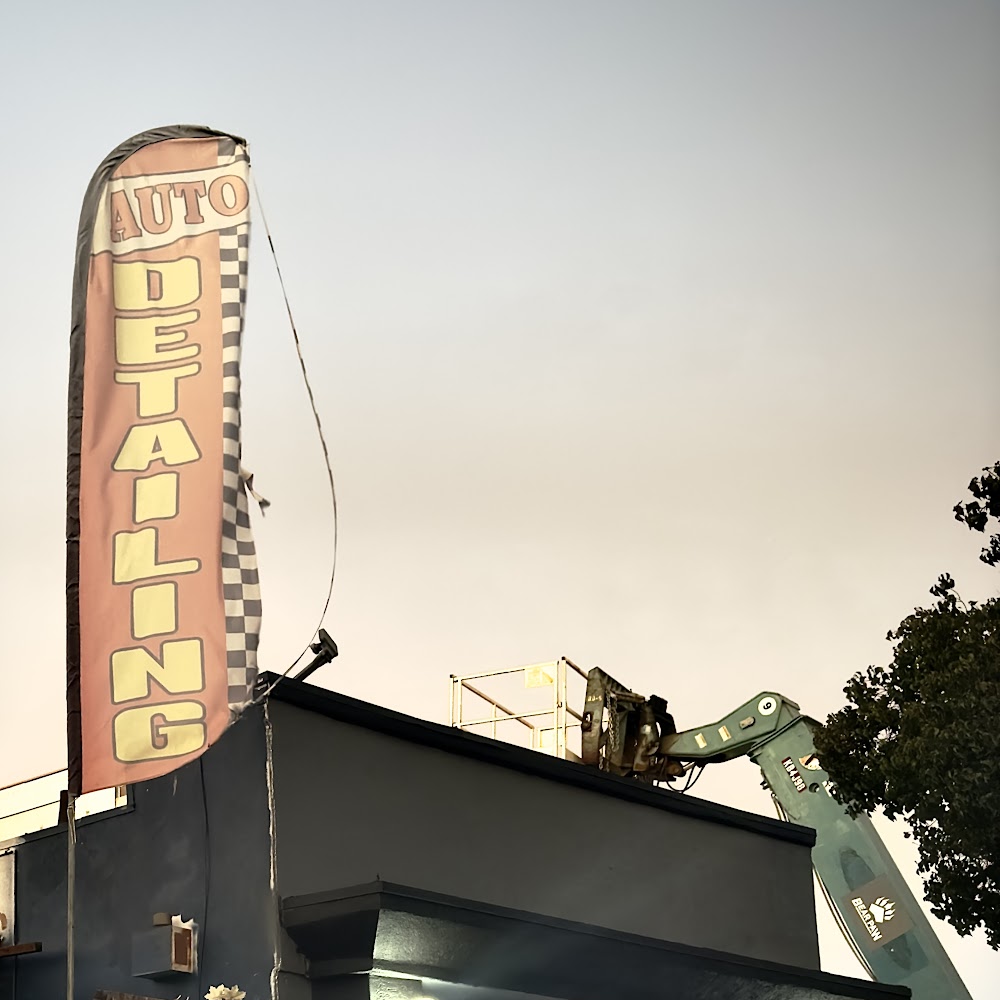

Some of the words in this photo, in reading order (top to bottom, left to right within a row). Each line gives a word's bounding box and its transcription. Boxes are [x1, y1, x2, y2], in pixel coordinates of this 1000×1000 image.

[110, 174, 250, 243] AUTO
[111, 255, 208, 763] DETAILING
[851, 897, 871, 922] BEAR
[866, 919, 883, 941] PAW
